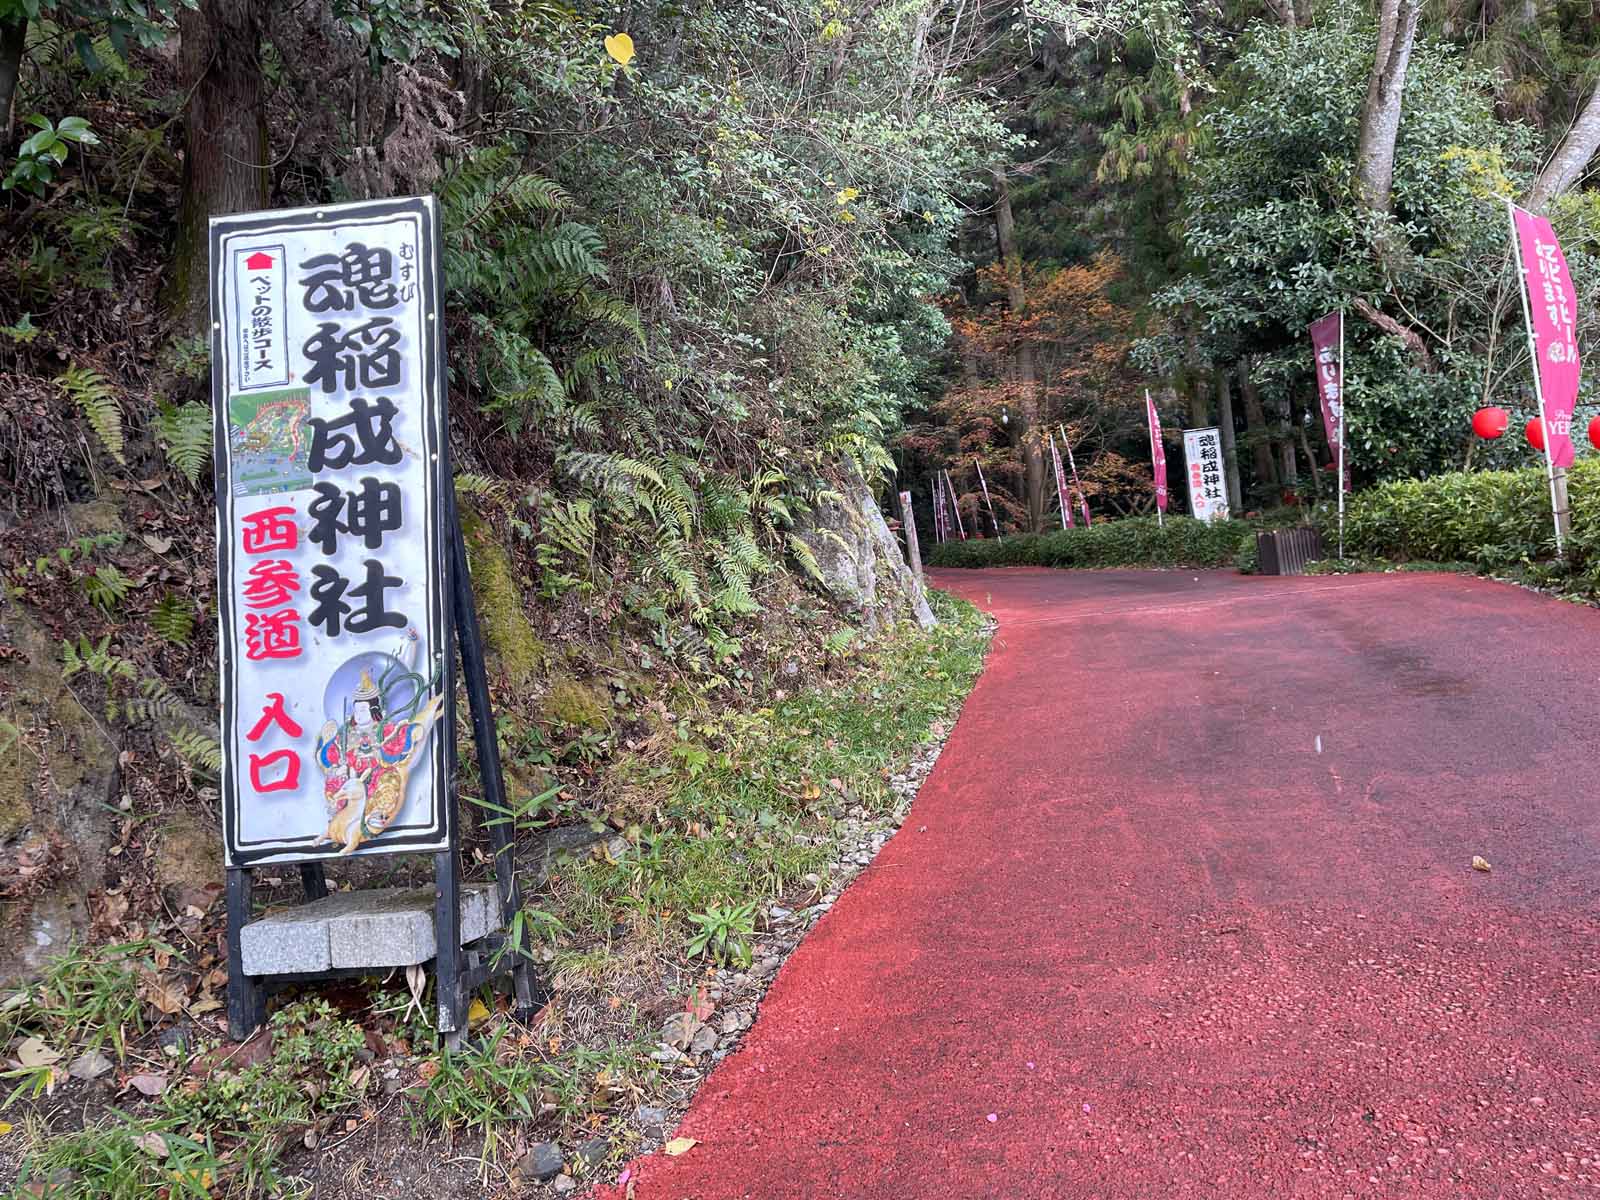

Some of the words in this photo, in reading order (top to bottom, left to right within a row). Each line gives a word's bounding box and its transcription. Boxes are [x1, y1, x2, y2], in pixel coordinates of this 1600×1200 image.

[399, 242, 415, 303] むすび
[250, 275, 274, 372] ペットの散歩コース
[299, 242, 409, 637] 魂稲成神社
[241, 506, 303, 660] 西参道
[246, 692, 303, 793] 入口
